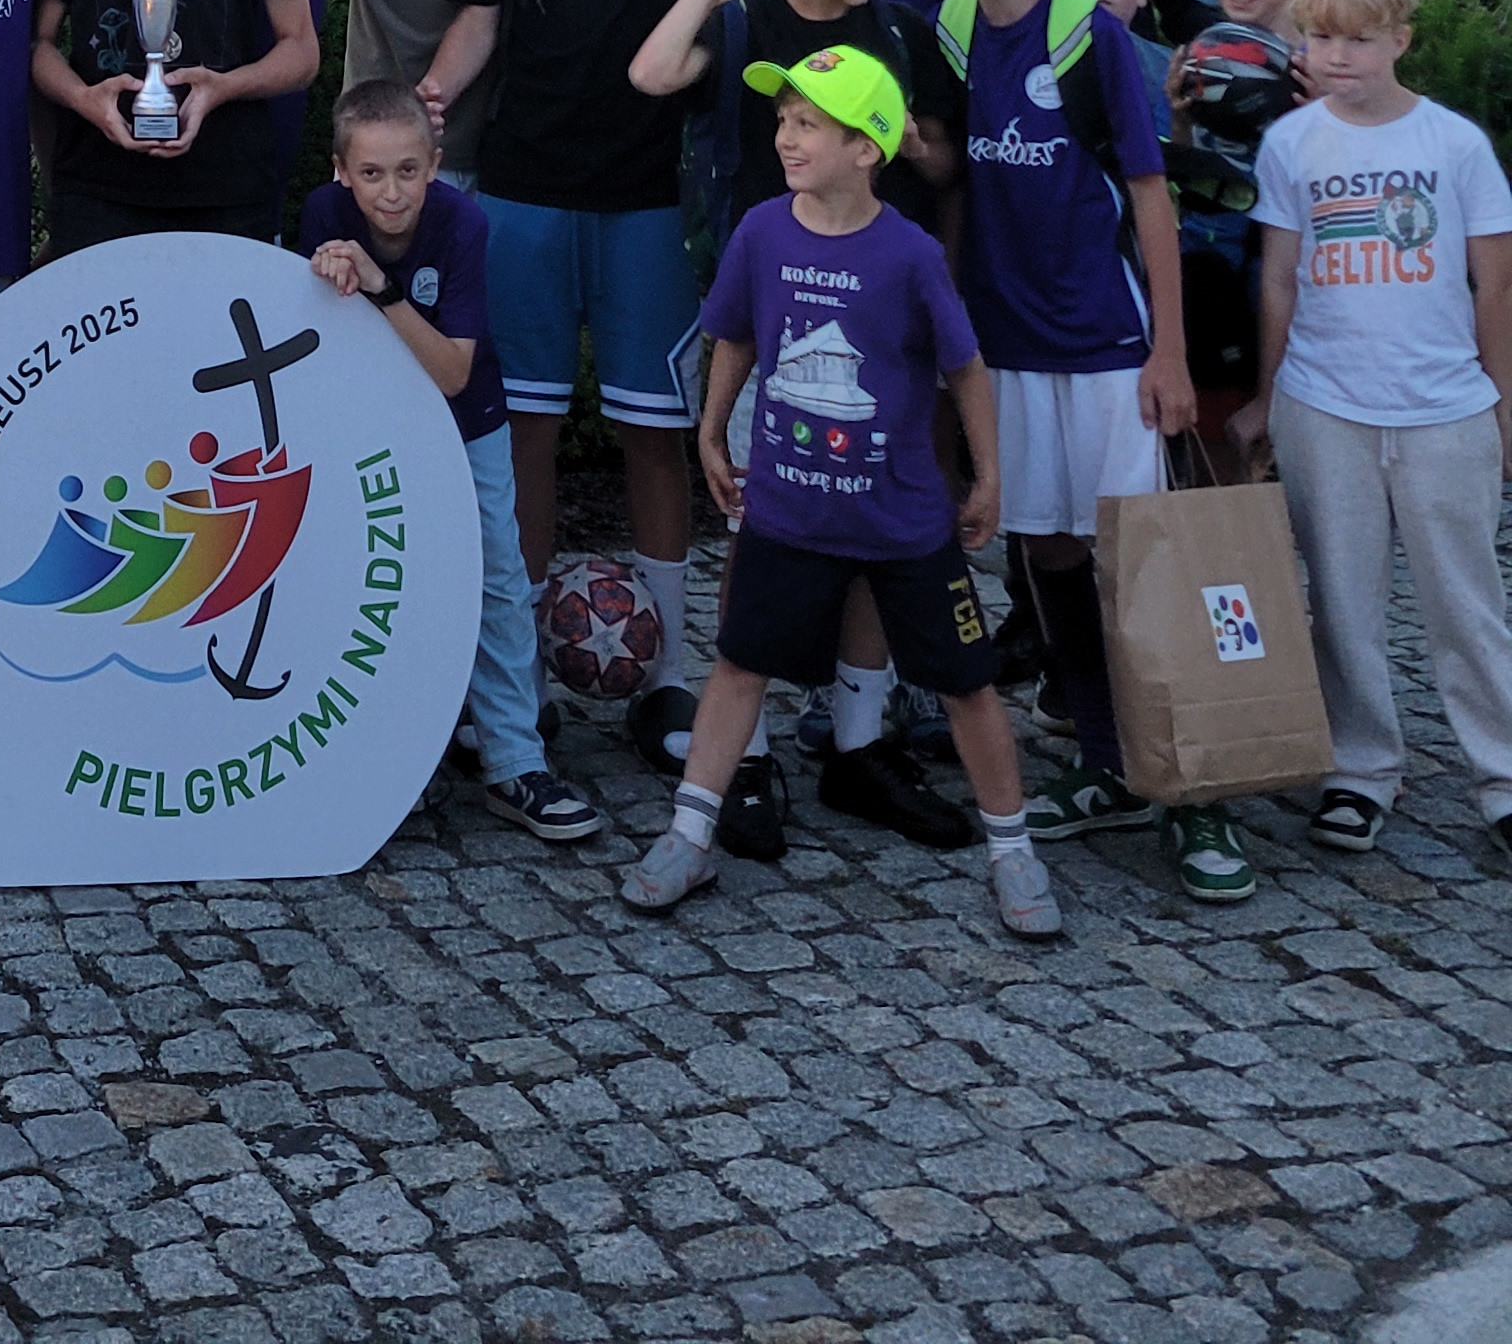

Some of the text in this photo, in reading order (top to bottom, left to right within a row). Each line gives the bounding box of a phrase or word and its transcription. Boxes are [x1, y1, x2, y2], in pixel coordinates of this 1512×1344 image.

[1309, 170, 1438, 202] BOSTON
[780, 264, 862, 292] KOŚCIÓŁ
[1310, 240, 1436, 287] CELTICS
[61, 297, 139, 355] 2025
[64, 448, 406, 817] PIELGRZYMI NADZIEI
[948, 577, 983, 644] FCB
